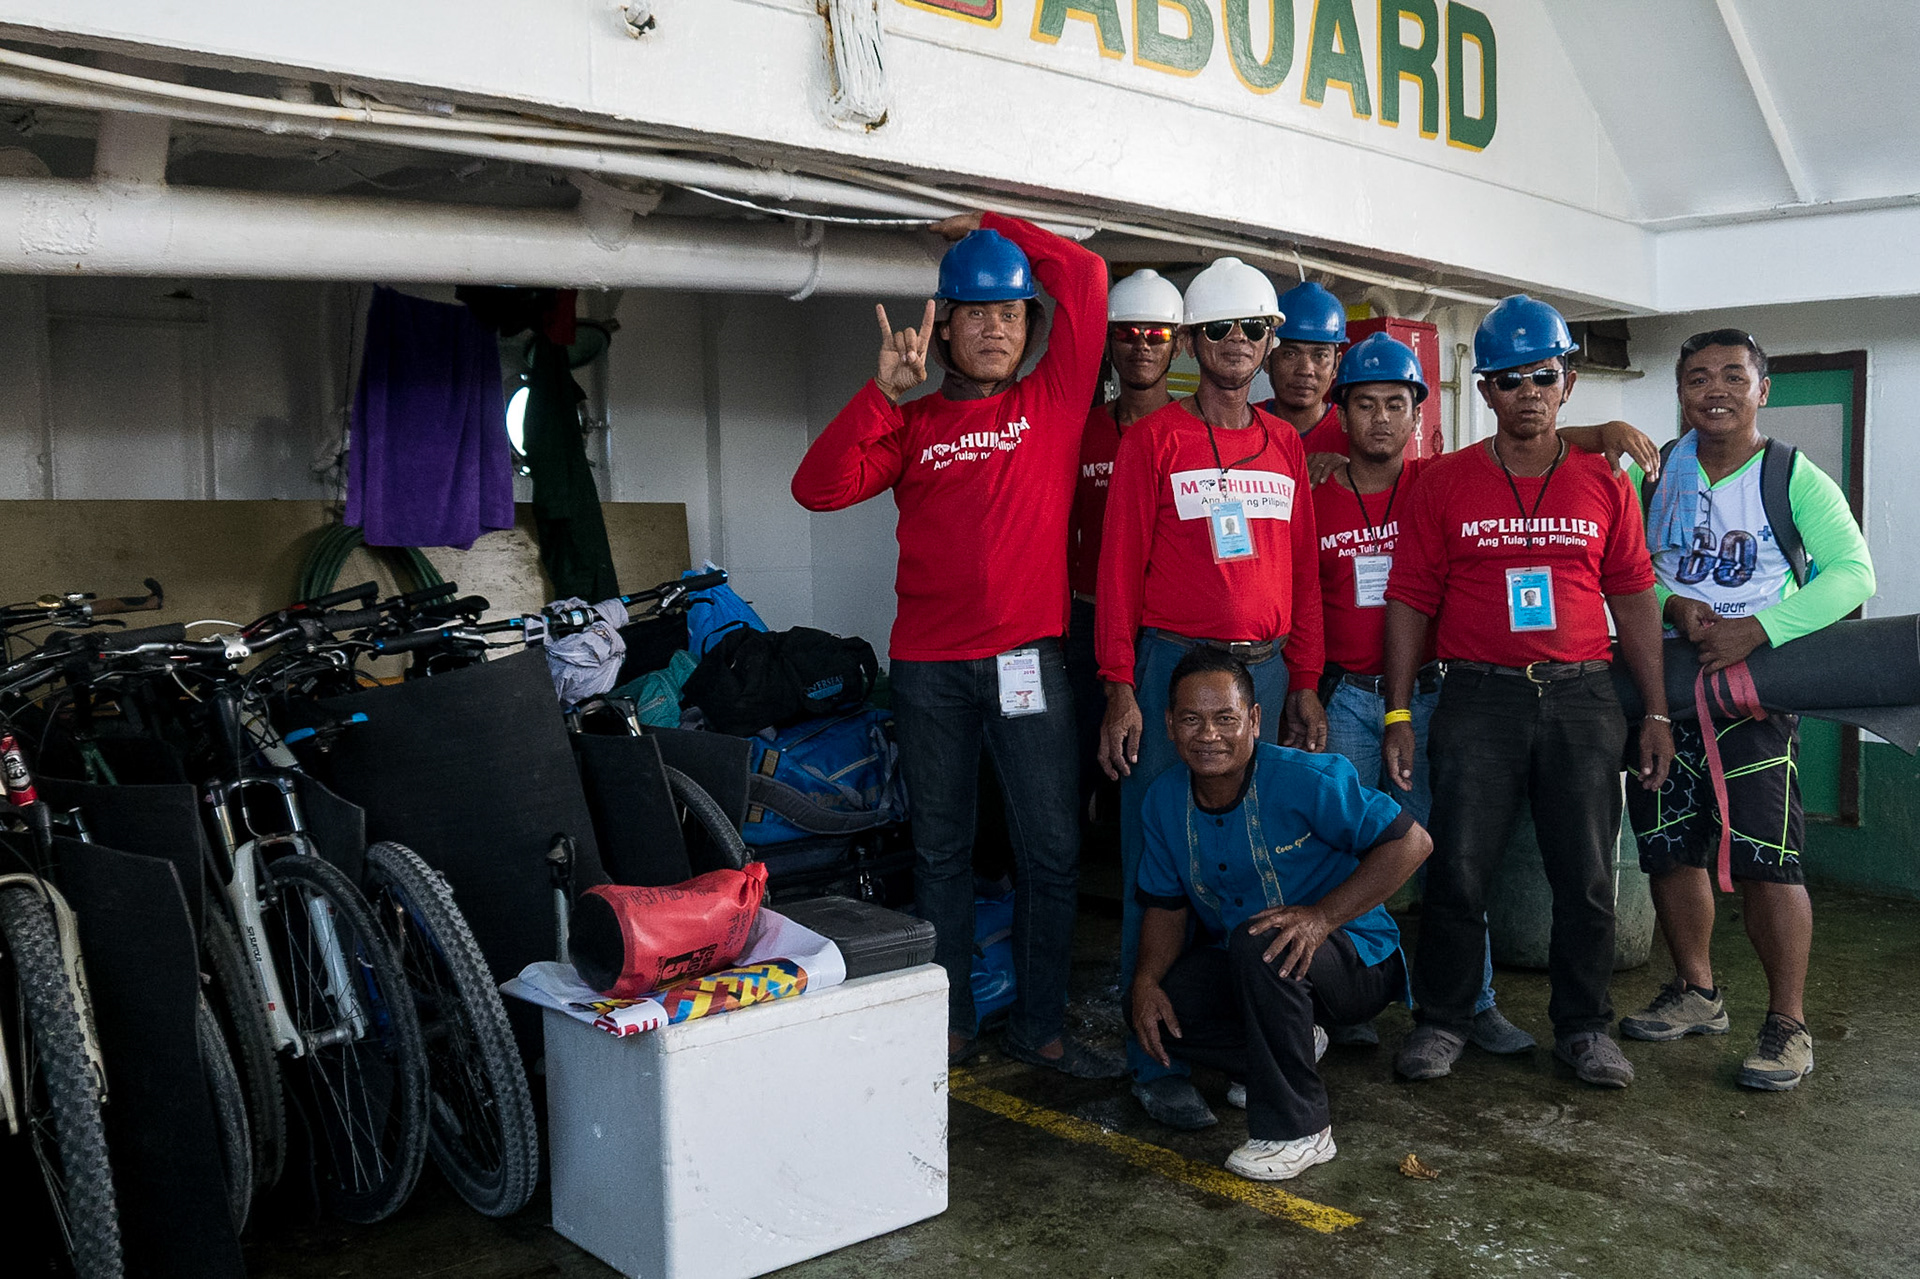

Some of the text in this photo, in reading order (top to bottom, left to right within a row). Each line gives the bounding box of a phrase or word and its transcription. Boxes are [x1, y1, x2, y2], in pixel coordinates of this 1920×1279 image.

[1246, 499, 1260, 508] ng
[1477, 534, 1588, 548] Ang Tulay ng Pilipino
[1713, 601, 1747, 614] HOUR
